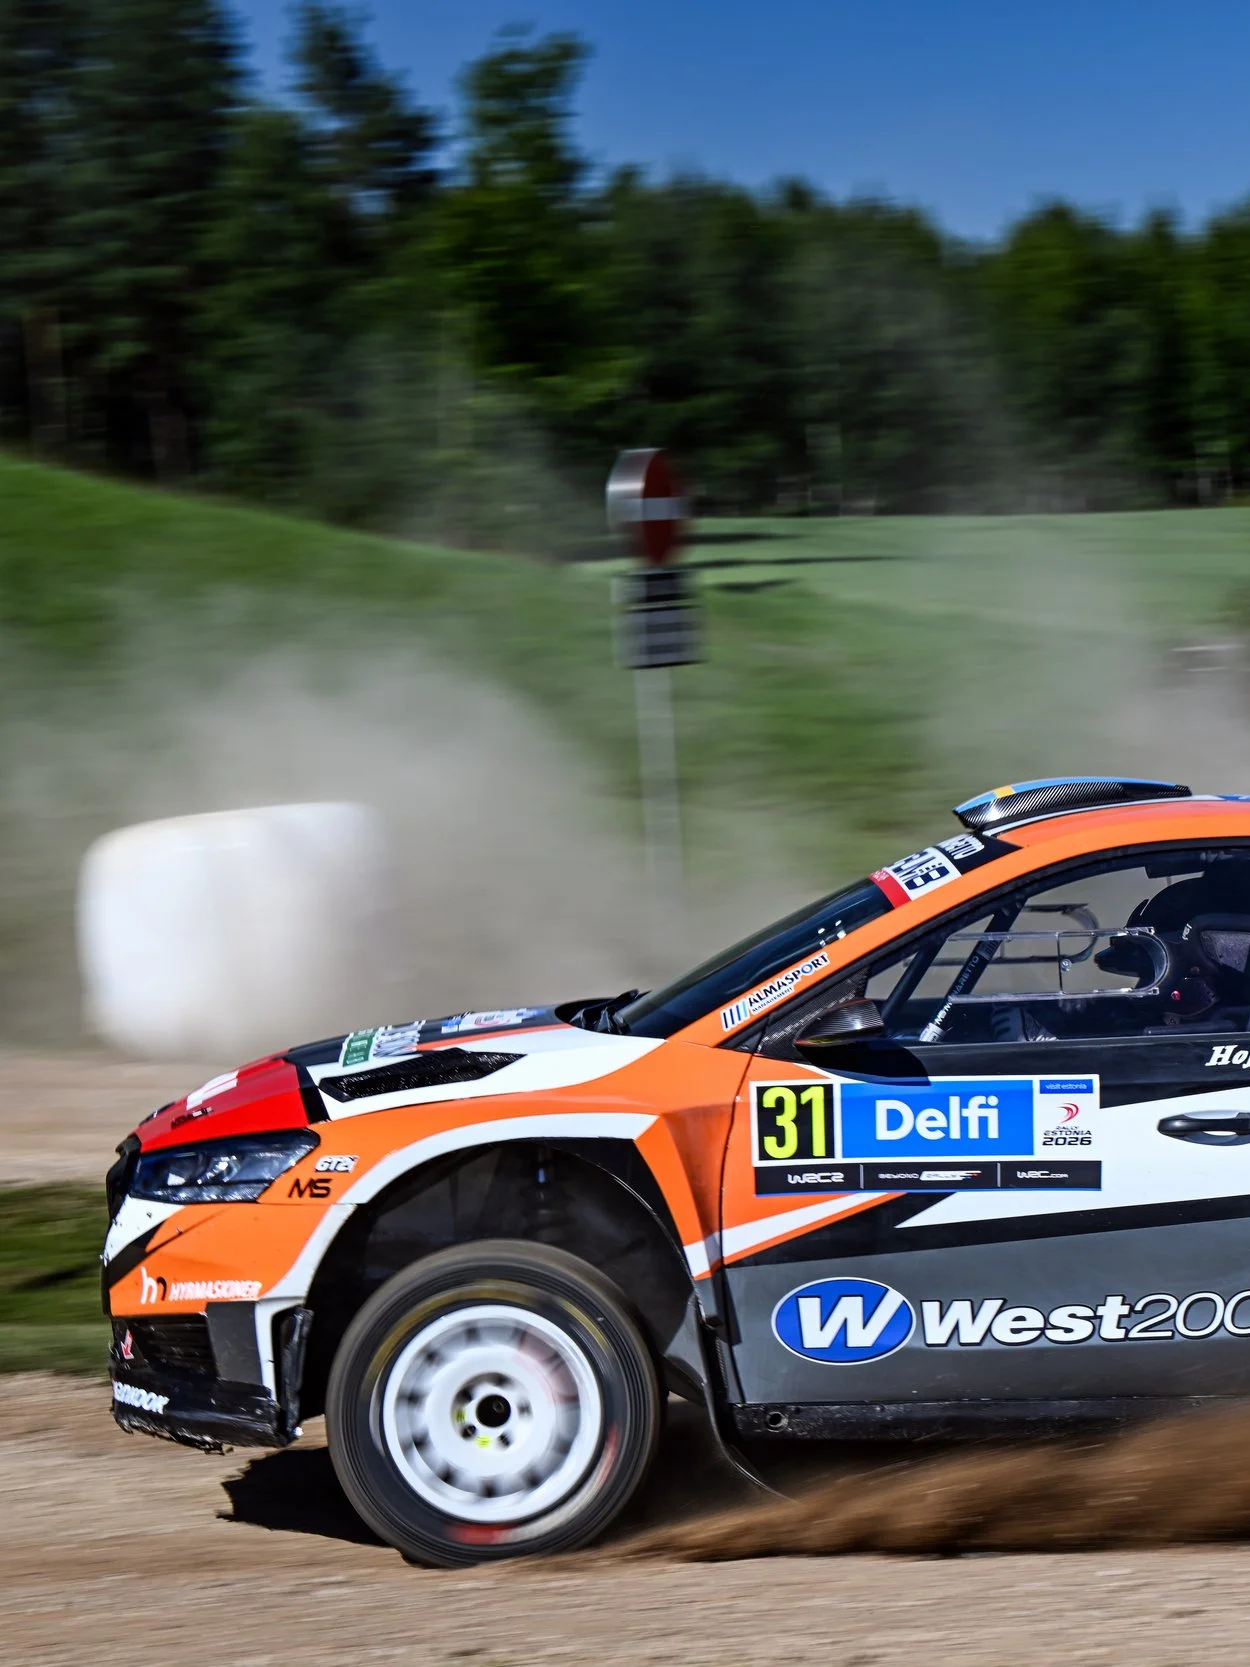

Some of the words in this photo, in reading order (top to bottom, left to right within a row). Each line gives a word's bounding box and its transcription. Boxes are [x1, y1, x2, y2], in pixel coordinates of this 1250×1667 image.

[748, 953, 829, 1007] ALMASPORT
[762, 1086, 826, 1159] 31
[875, 1095, 999, 1141] Delfi
[1042, 1136, 1092, 1146] 2026
[288, 1178, 332, 1198] MS
[788, 1172, 844, 1184] WRC2
